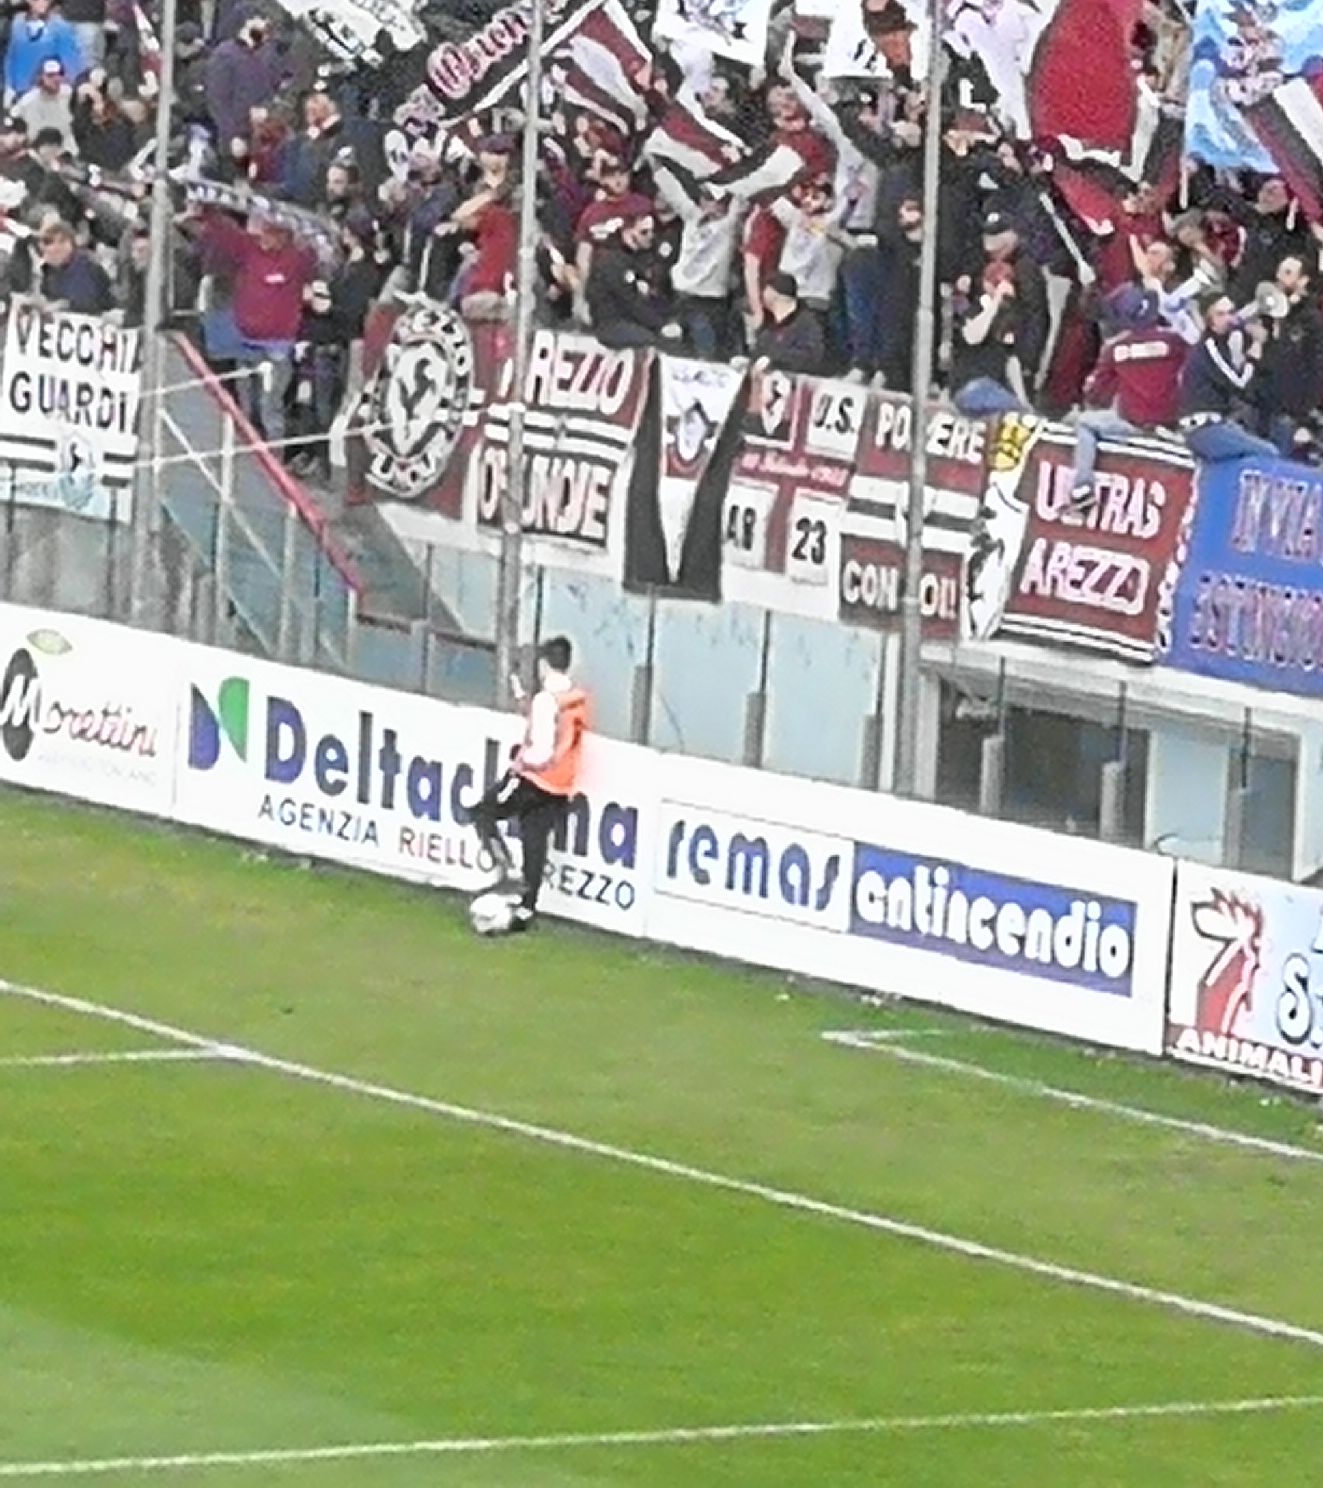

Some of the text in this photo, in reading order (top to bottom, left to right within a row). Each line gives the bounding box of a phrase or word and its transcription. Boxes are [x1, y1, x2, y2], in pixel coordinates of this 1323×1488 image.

[259, 794, 380, 849] AGENZIA
[399, 827, 494, 874] RIELLO
[666, 818, 841, 912] remas
[856, 867, 1132, 979] antincendio
[1174, 1026, 1322, 1087] ANIMALI
